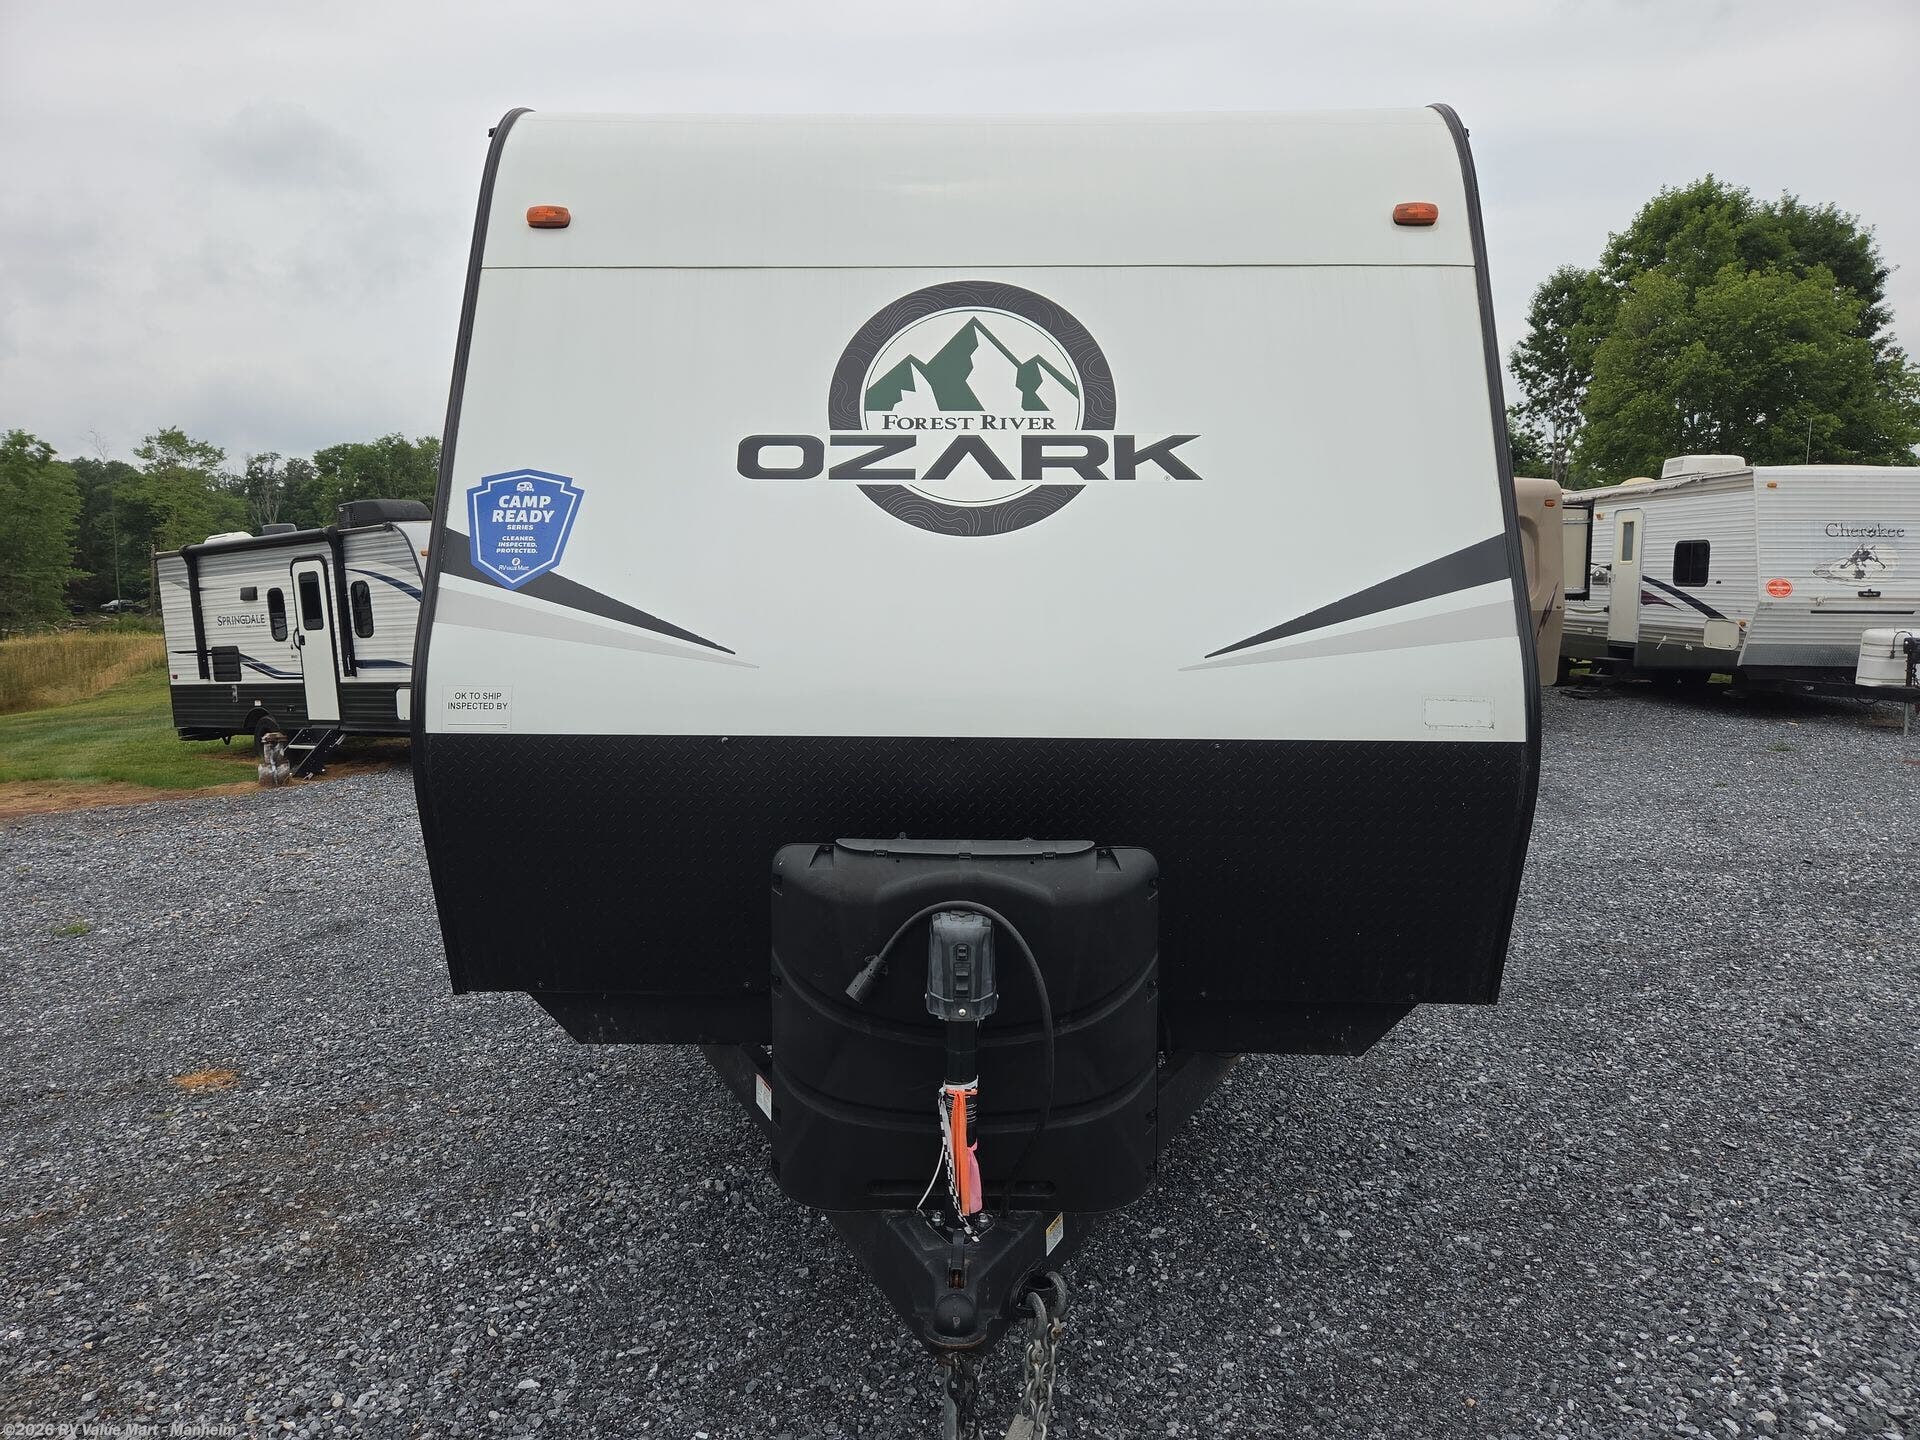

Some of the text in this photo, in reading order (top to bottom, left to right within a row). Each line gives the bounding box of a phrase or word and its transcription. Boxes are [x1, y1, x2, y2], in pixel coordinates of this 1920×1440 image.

[882, 414, 1056, 430] FOREST RIVER
[736, 434, 1204, 480] OZARK
[499, 495, 552, 508] CAMP
[492, 510, 555, 523] READY
[1825, 523, 1905, 538] Cherokee
[217, 614, 265, 626] SPRINGDALE
[447, 702, 508, 710] INSPECTED BY
